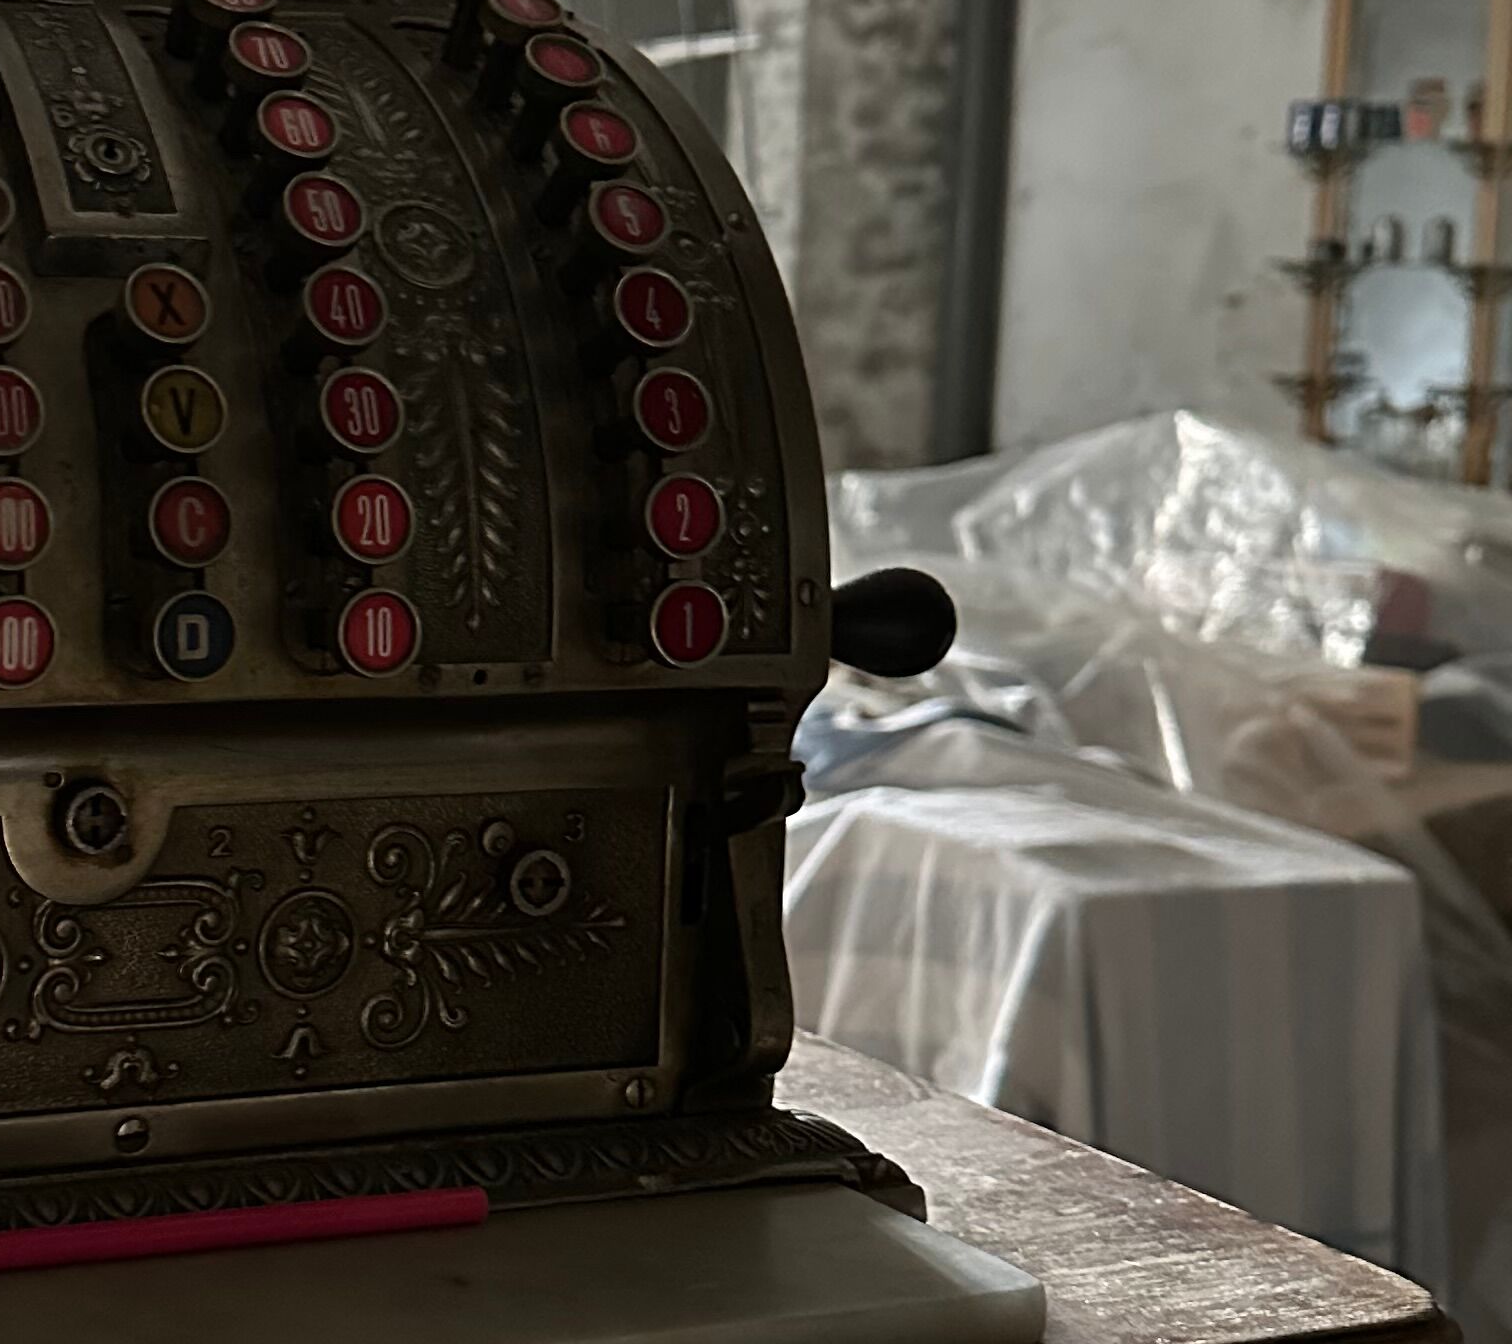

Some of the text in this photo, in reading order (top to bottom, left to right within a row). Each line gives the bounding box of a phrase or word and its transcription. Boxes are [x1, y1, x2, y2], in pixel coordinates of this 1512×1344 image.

[250, 35, 291, 71] 70
[278, 107, 320, 149] 60
[305, 187, 347, 234] 50
[615, 193, 644, 238] 5
[147, 280, 188, 327] X
[329, 282, 366, 331] 40
[644, 286, 664, 334] 4
[342, 385, 382, 438] 30
[663, 386, 682, 436] 3
[176, 495, 205, 549] C
[355, 493, 392, 548] 20
[674, 491, 693, 543] 2
[176, 612, 210, 662] D
[364, 605, 393, 659] 10
[682, 599, 694, 650] 1
[207, 827, 231, 857] 2
